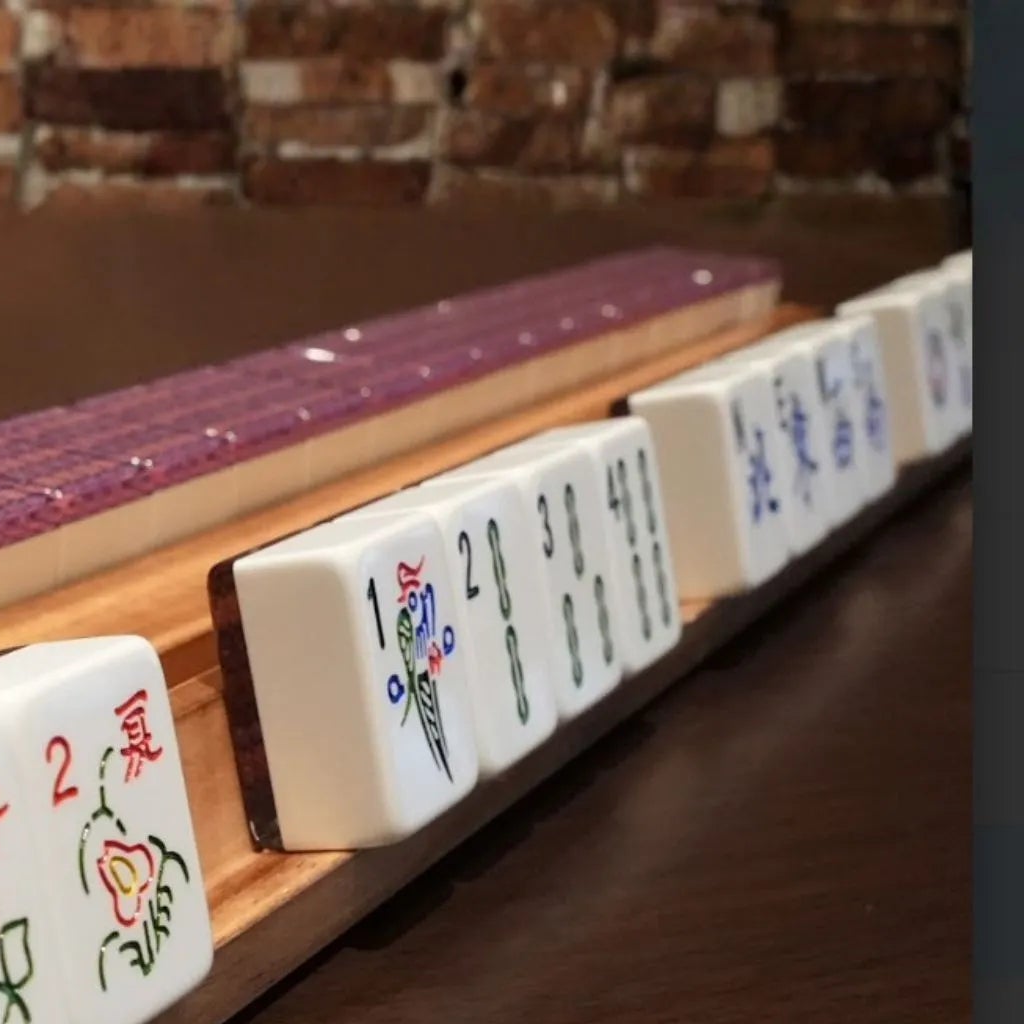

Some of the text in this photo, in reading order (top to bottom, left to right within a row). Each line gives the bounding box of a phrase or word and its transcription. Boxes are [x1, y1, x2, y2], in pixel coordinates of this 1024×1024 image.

[537, 494, 554, 558] 3
[606, 464, 620, 521] 4
[458, 531, 480, 600] 2
[367, 577, 385, 650] 1
[45, 735, 78, 806] 2
